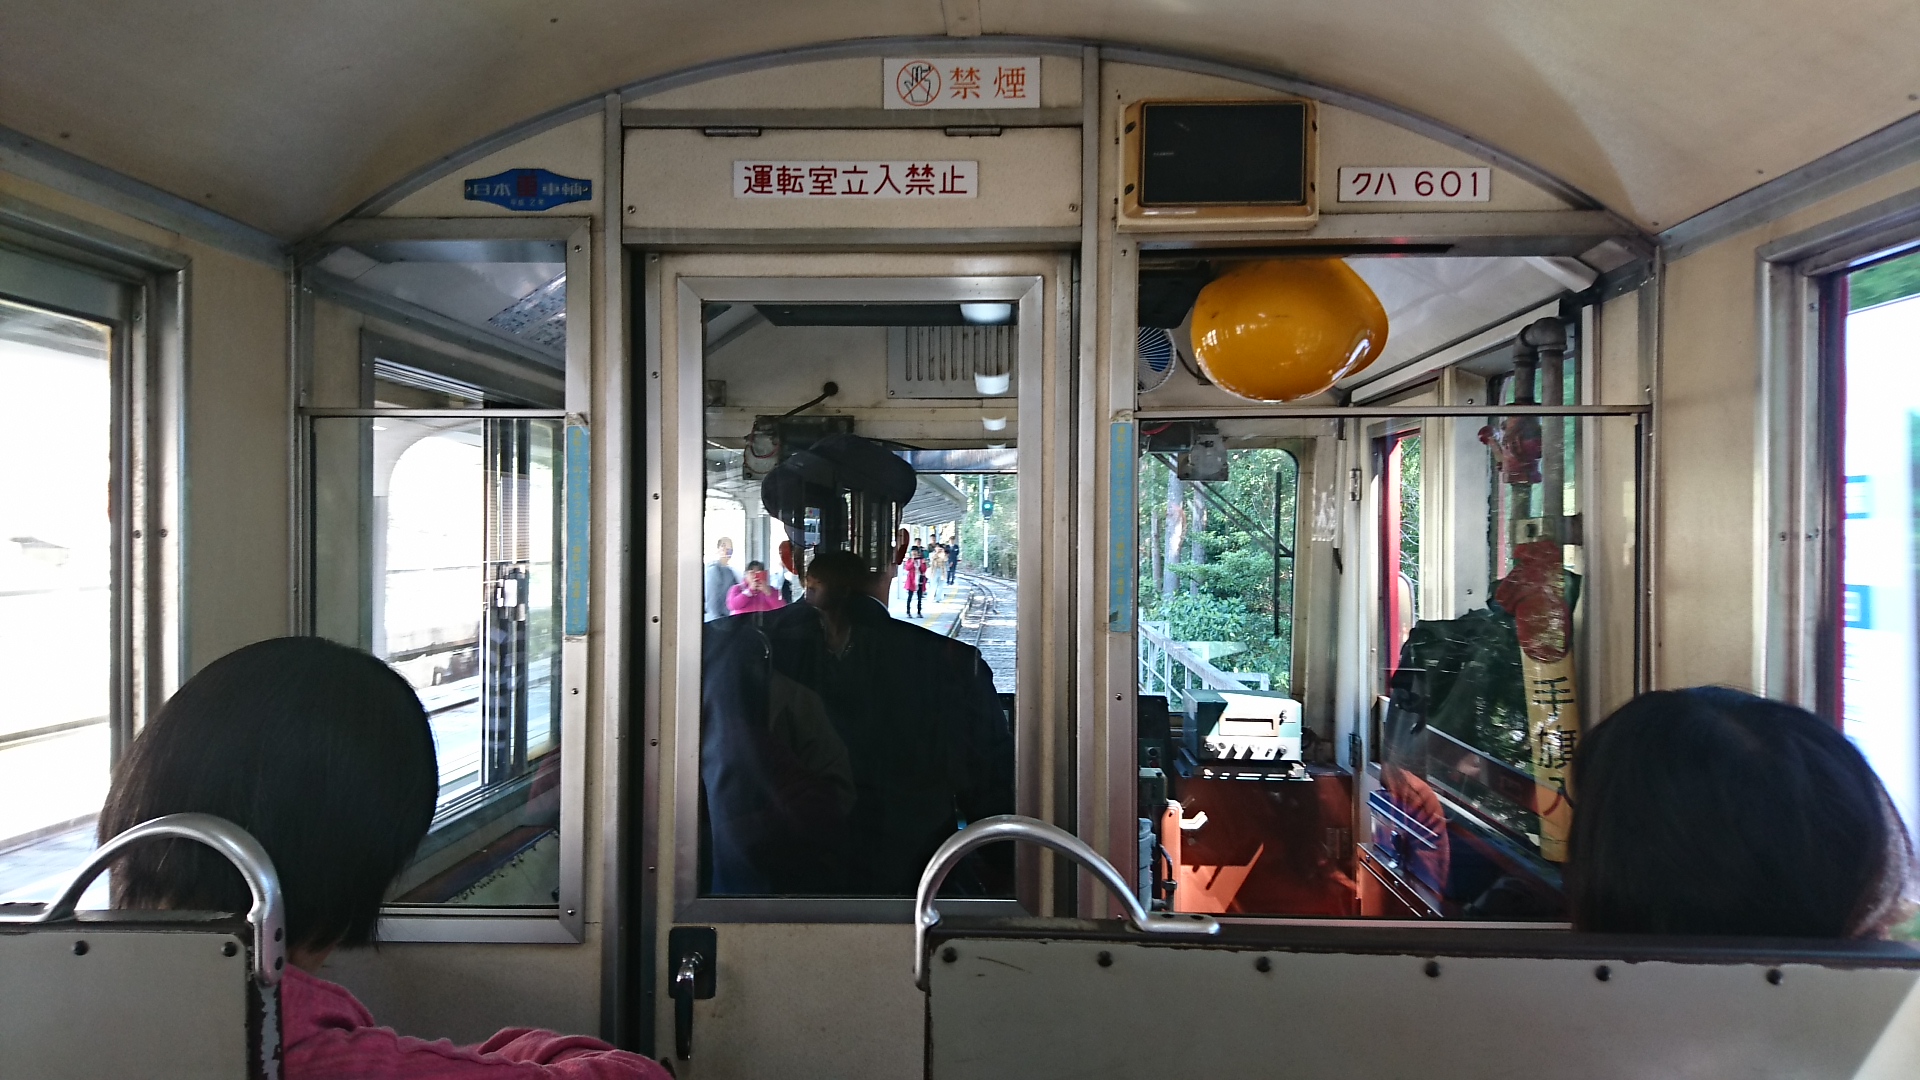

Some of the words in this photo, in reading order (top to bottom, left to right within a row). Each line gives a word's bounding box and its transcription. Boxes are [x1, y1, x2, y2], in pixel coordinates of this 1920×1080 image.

[949, 66, 1026, 100] 禁煙
[743, 163, 968, 196] 運転室立入禁止
[1352, 172, 1397, 196] クハ
[1414, 171, 1477, 197] 601
